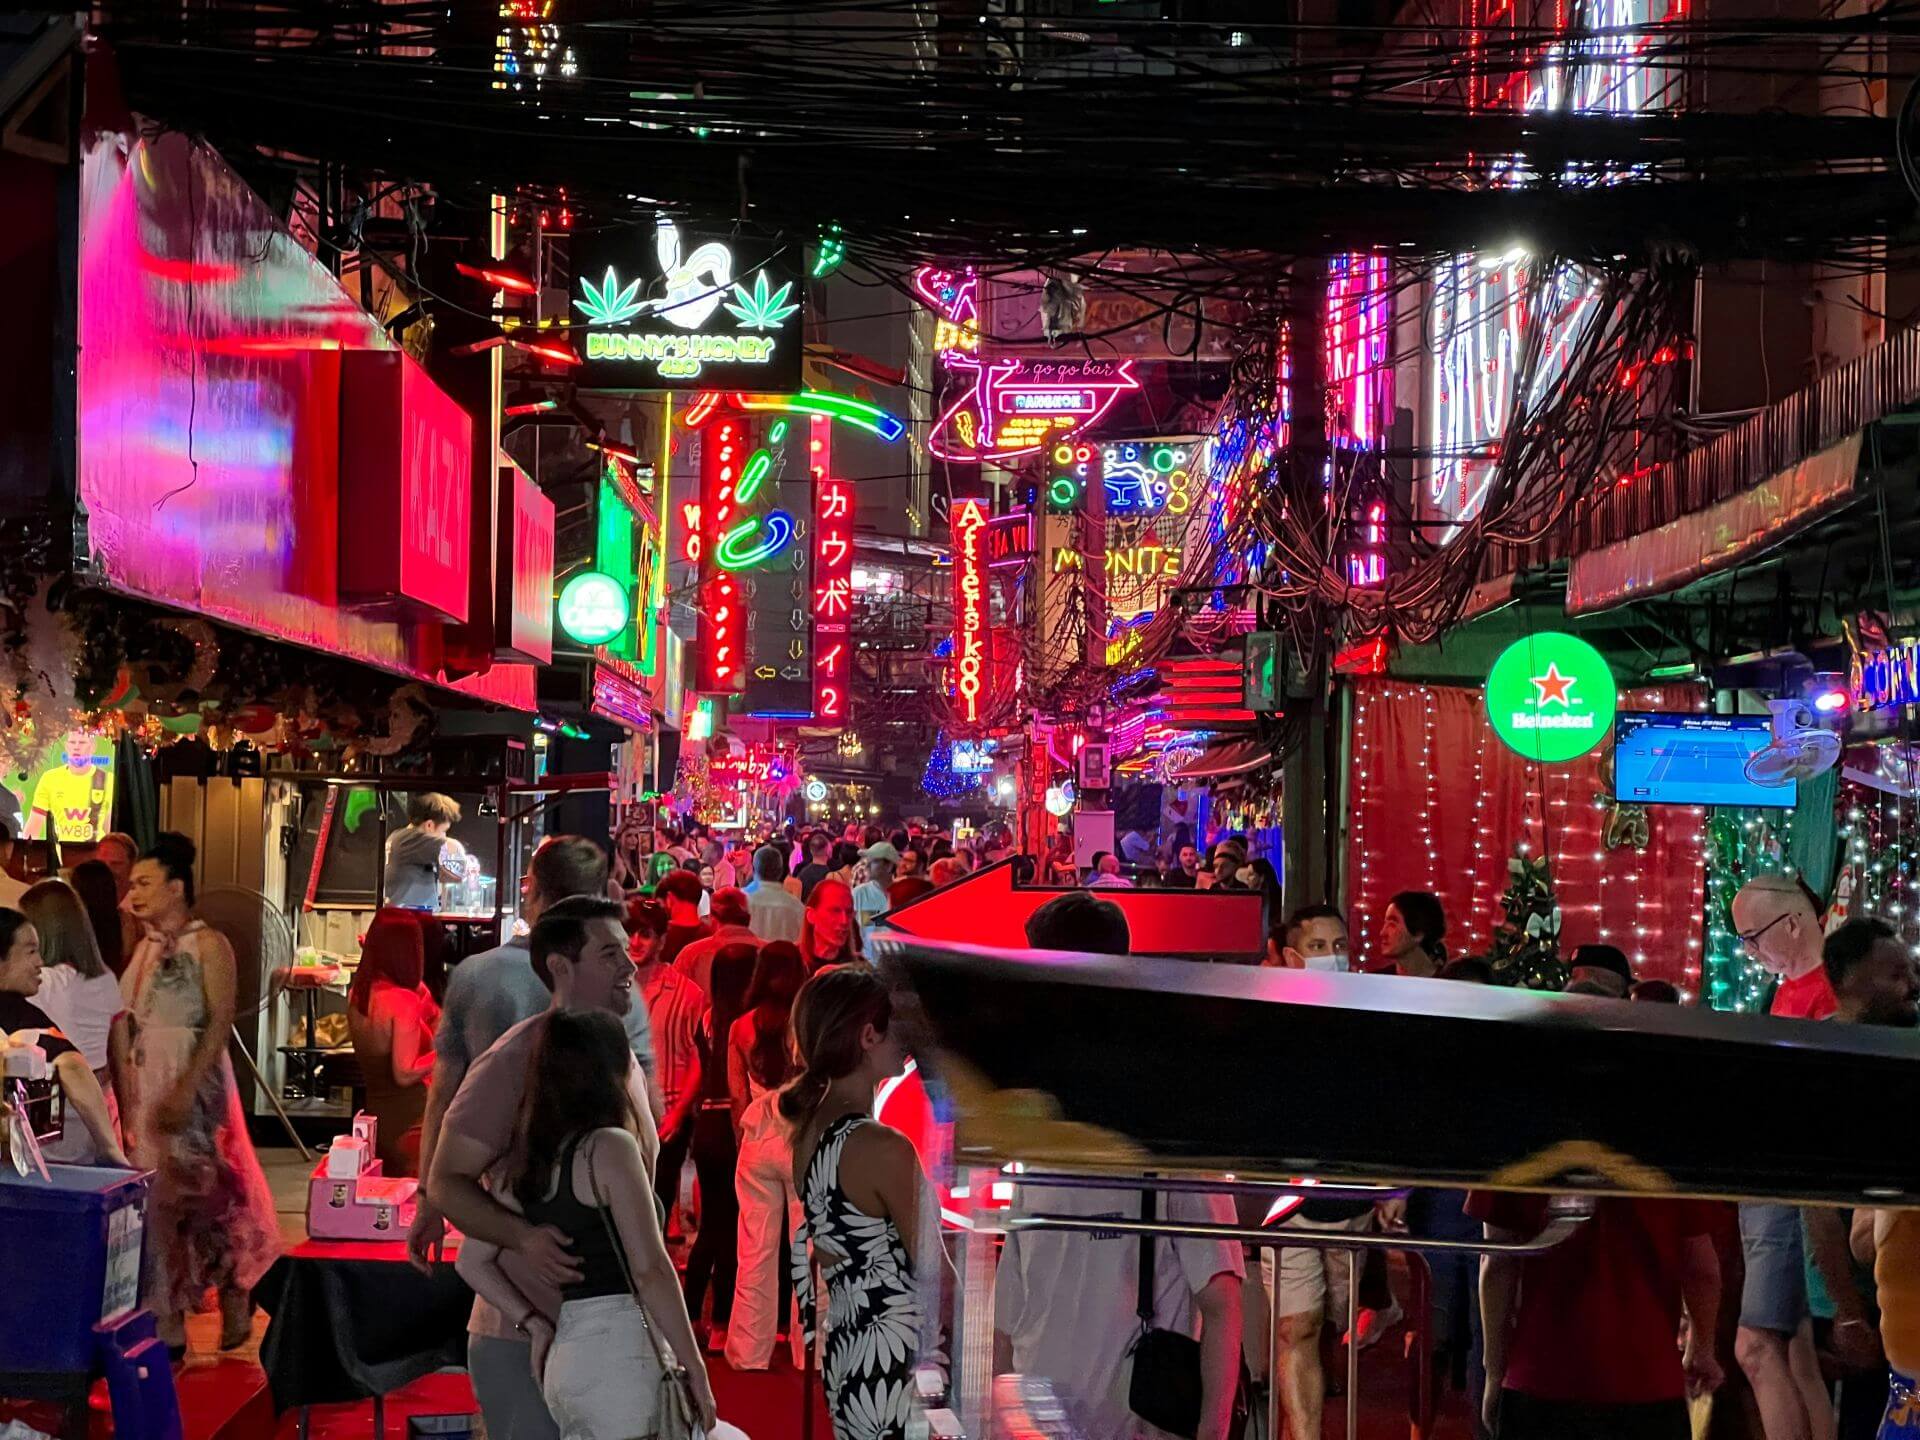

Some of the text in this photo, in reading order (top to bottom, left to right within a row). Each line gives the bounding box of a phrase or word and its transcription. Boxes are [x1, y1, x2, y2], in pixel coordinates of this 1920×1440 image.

[587, 333, 776, 363] BUNNY'S HONEY
[657, 357, 701, 378] 420
[1082, 360, 1114, 376] bar
[1511, 711, 1594, 729] Heineken
[61, 825, 92, 837] W88
